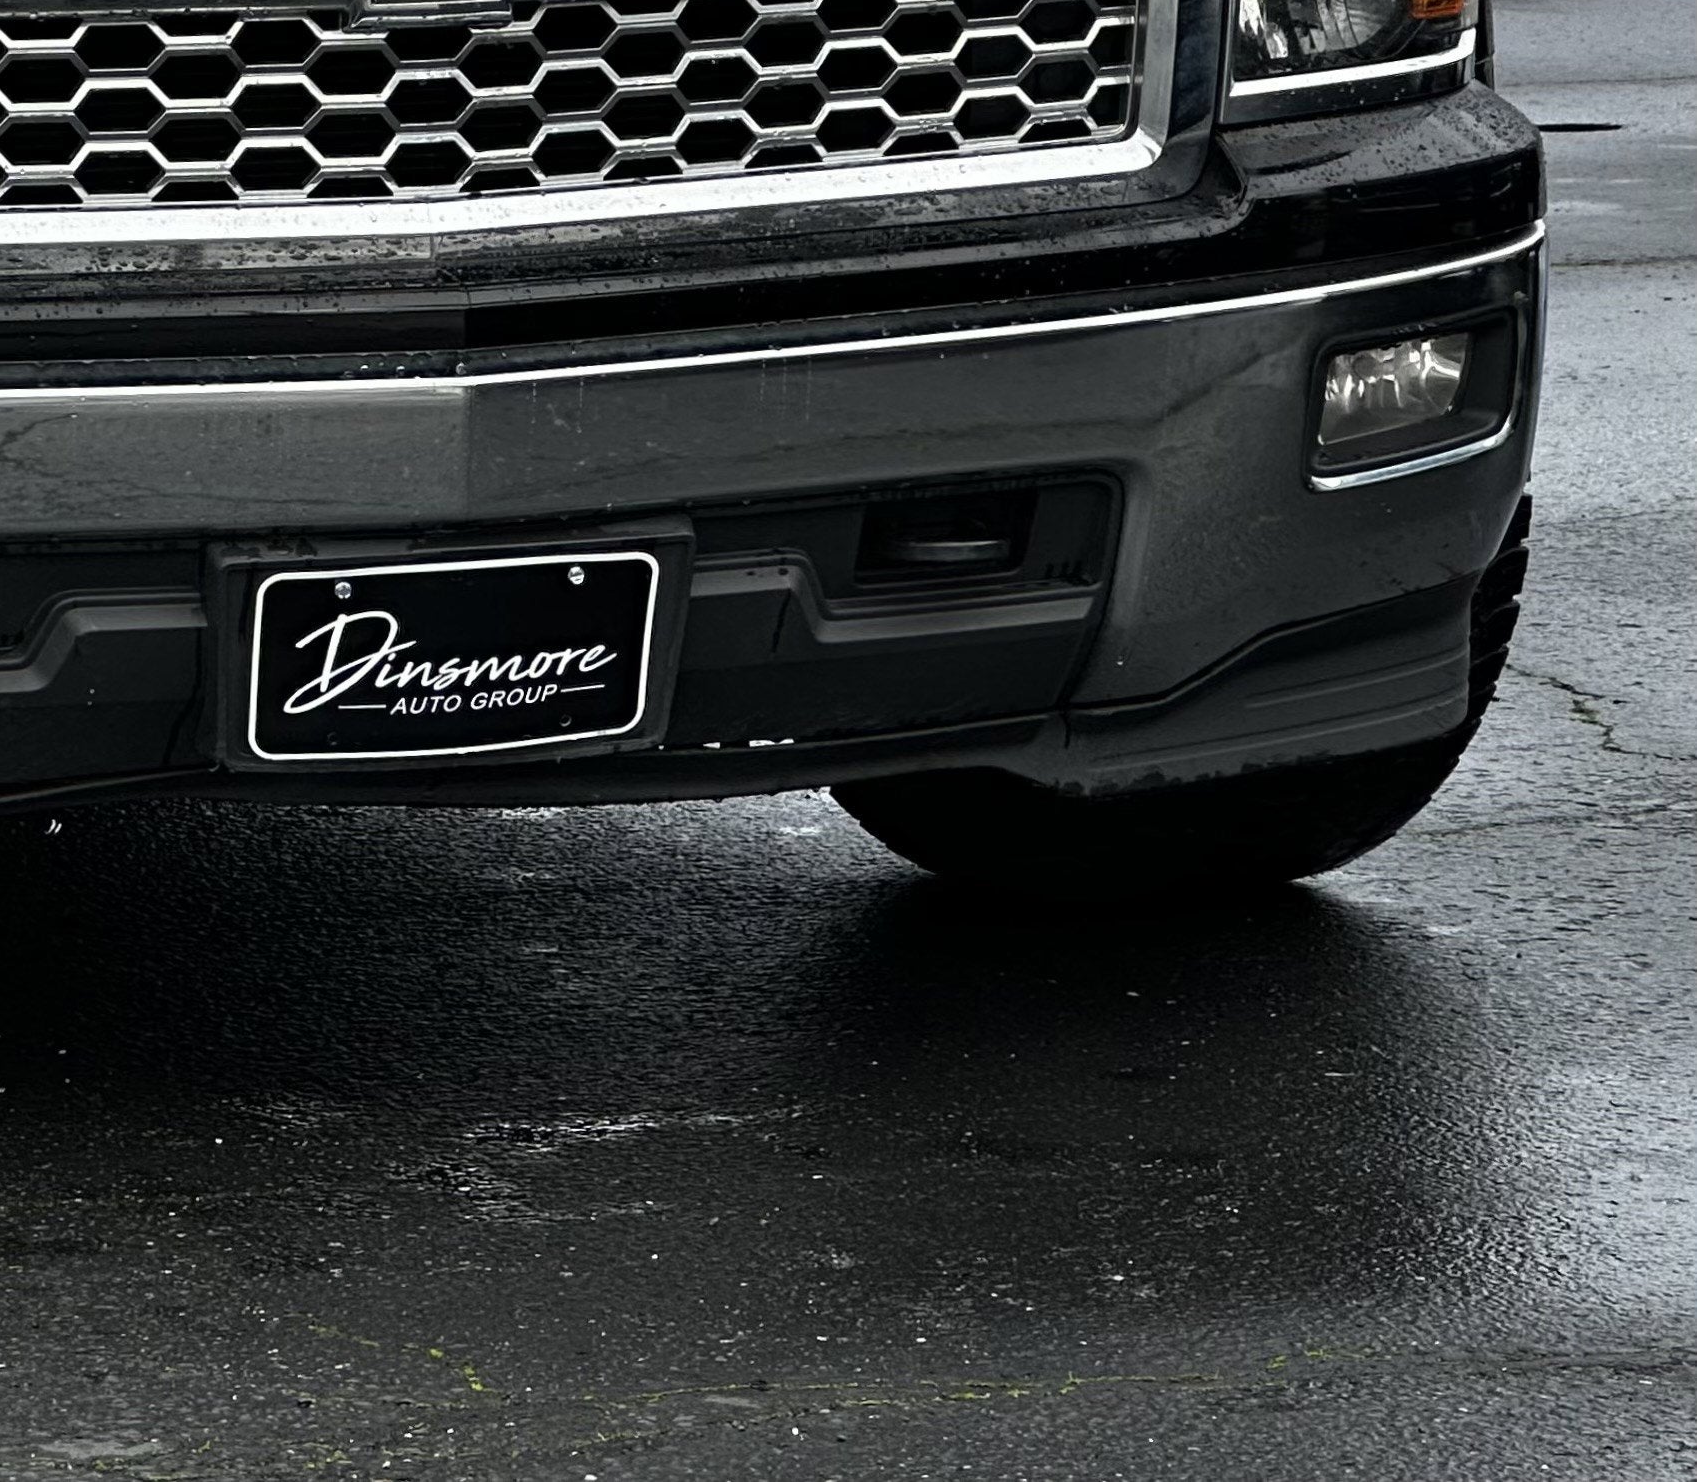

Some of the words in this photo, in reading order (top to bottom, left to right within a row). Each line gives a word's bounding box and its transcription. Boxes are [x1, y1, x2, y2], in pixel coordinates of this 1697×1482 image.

[283, 610, 618, 714] Dinsmore
[390, 695, 463, 716] AUTO
[470, 683, 559, 711] GROUP
